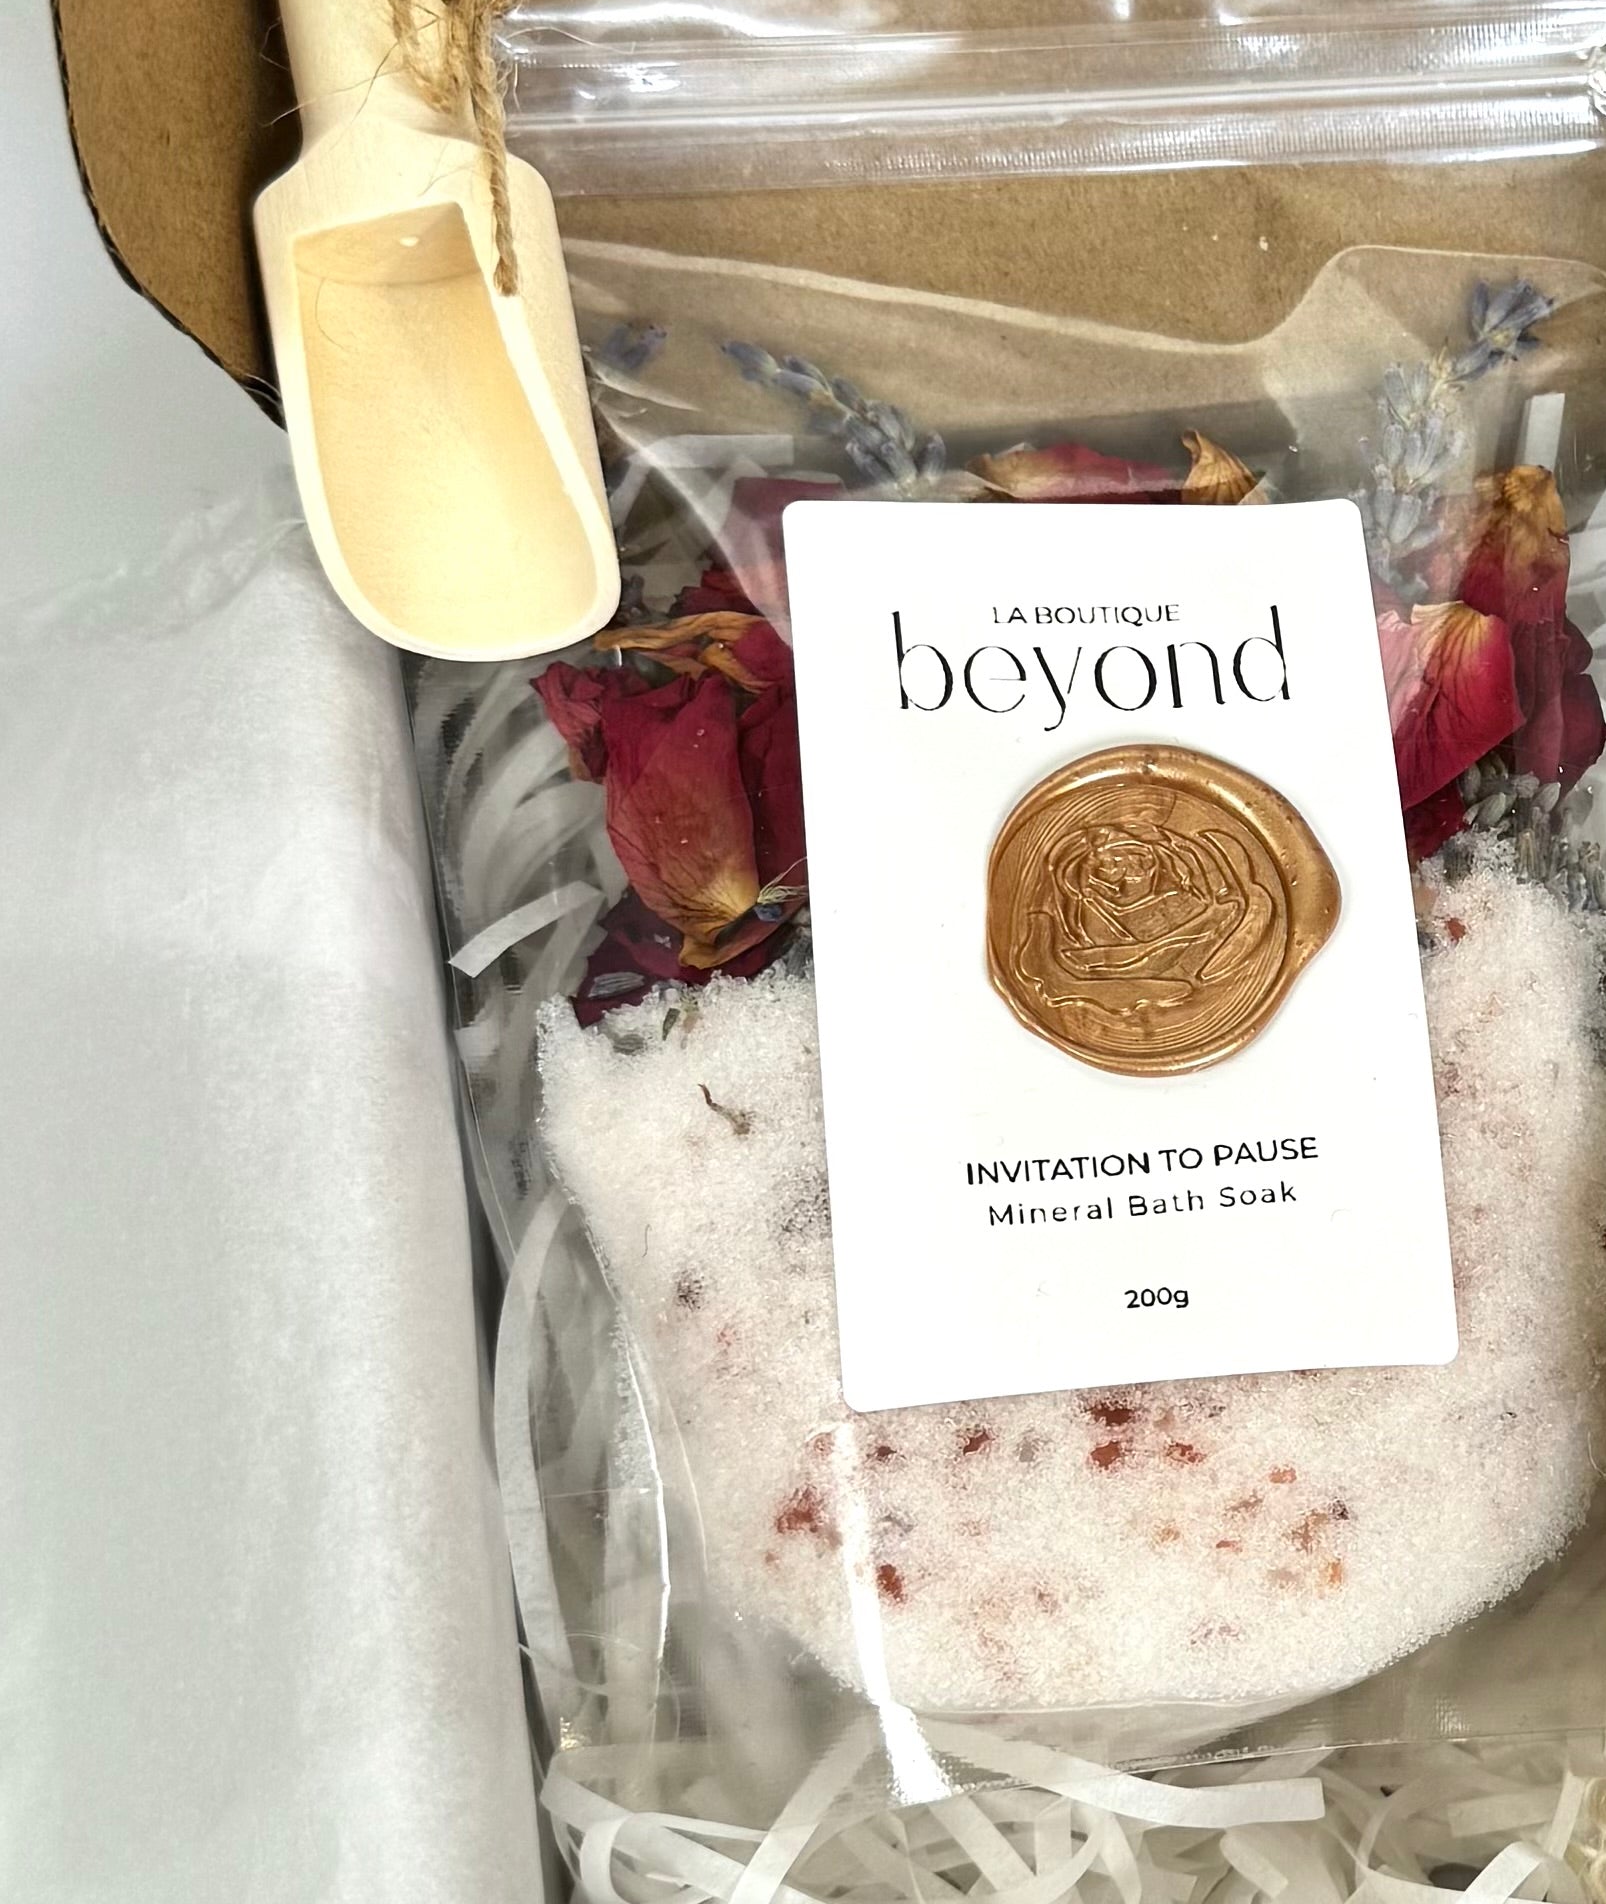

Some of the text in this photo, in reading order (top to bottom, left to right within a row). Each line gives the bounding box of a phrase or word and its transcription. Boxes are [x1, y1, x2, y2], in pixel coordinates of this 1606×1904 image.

[991, 602, 1181, 629] LA BOUTIQUE
[889, 602, 1292, 733] beyond
[965, 1135, 1320, 1187] INVITATION TO PAUSE
[987, 1179, 1298, 1228] Mineral Bath Soak
[1122, 1285, 1191, 1310] 200g
